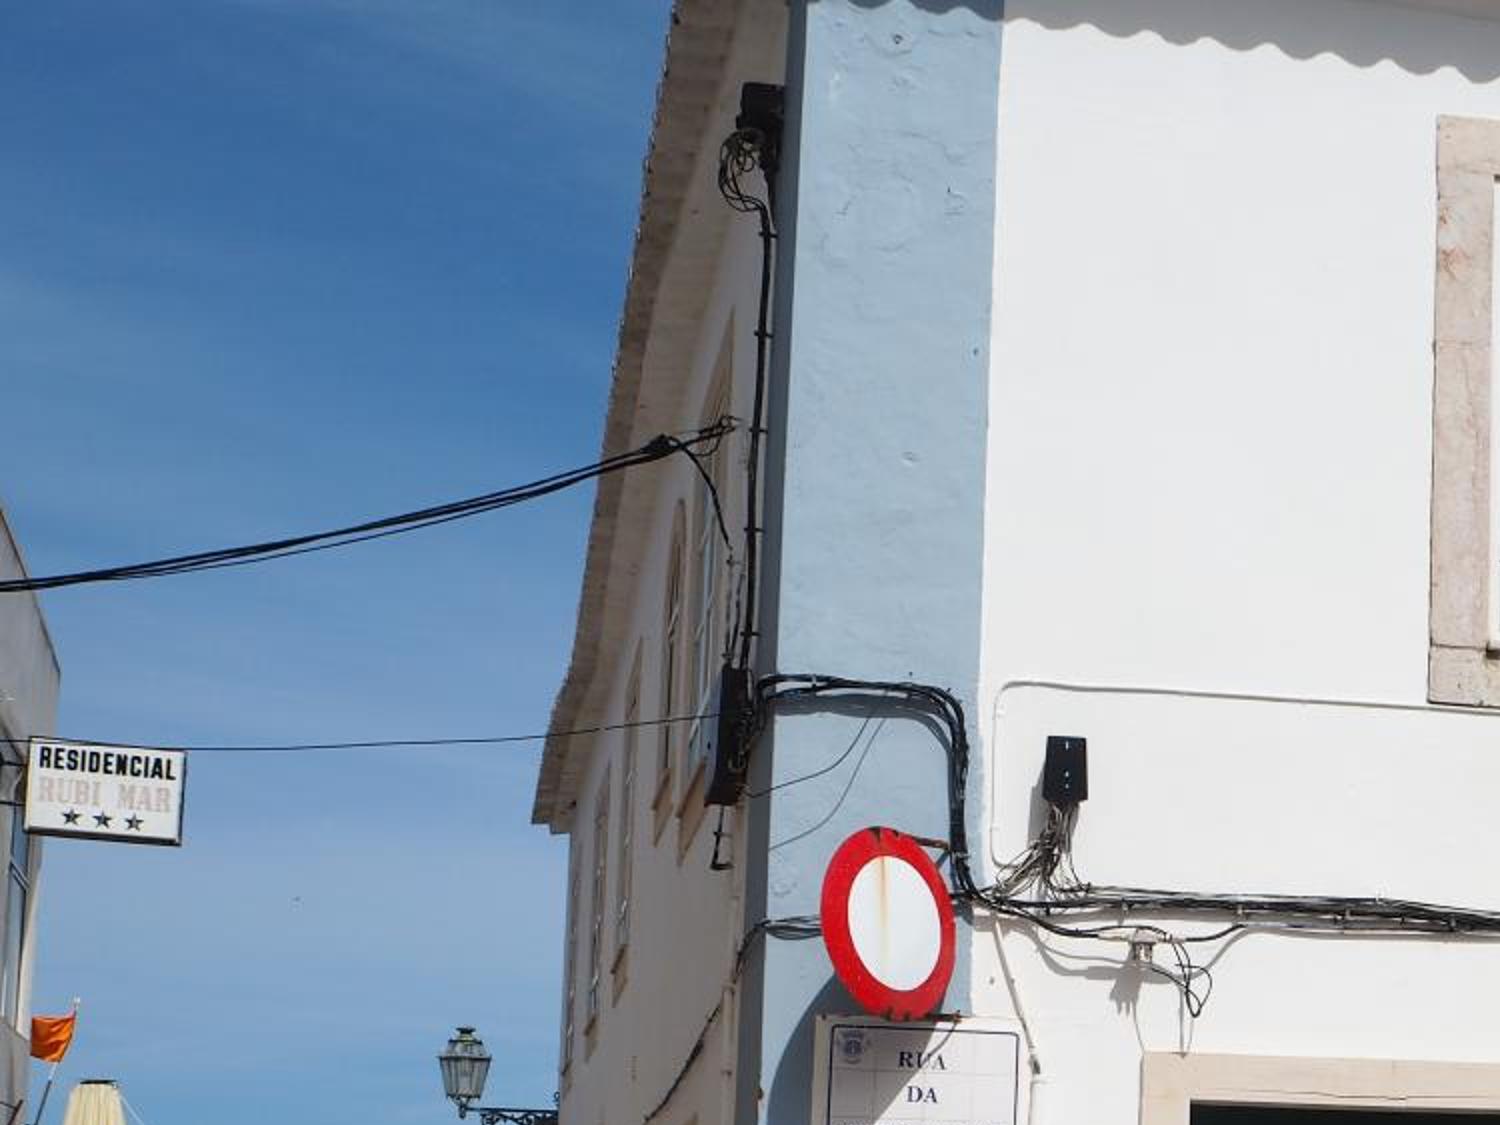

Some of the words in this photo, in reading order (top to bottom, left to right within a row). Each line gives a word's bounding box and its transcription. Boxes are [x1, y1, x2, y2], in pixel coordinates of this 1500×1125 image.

[39, 746, 177, 780] RESIDENCIAL
[39, 777, 101, 807] RUBI
[117, 780, 171, 813] MAR
[898, 1050, 946, 1071] RUA
[906, 1085, 938, 1104] DA
